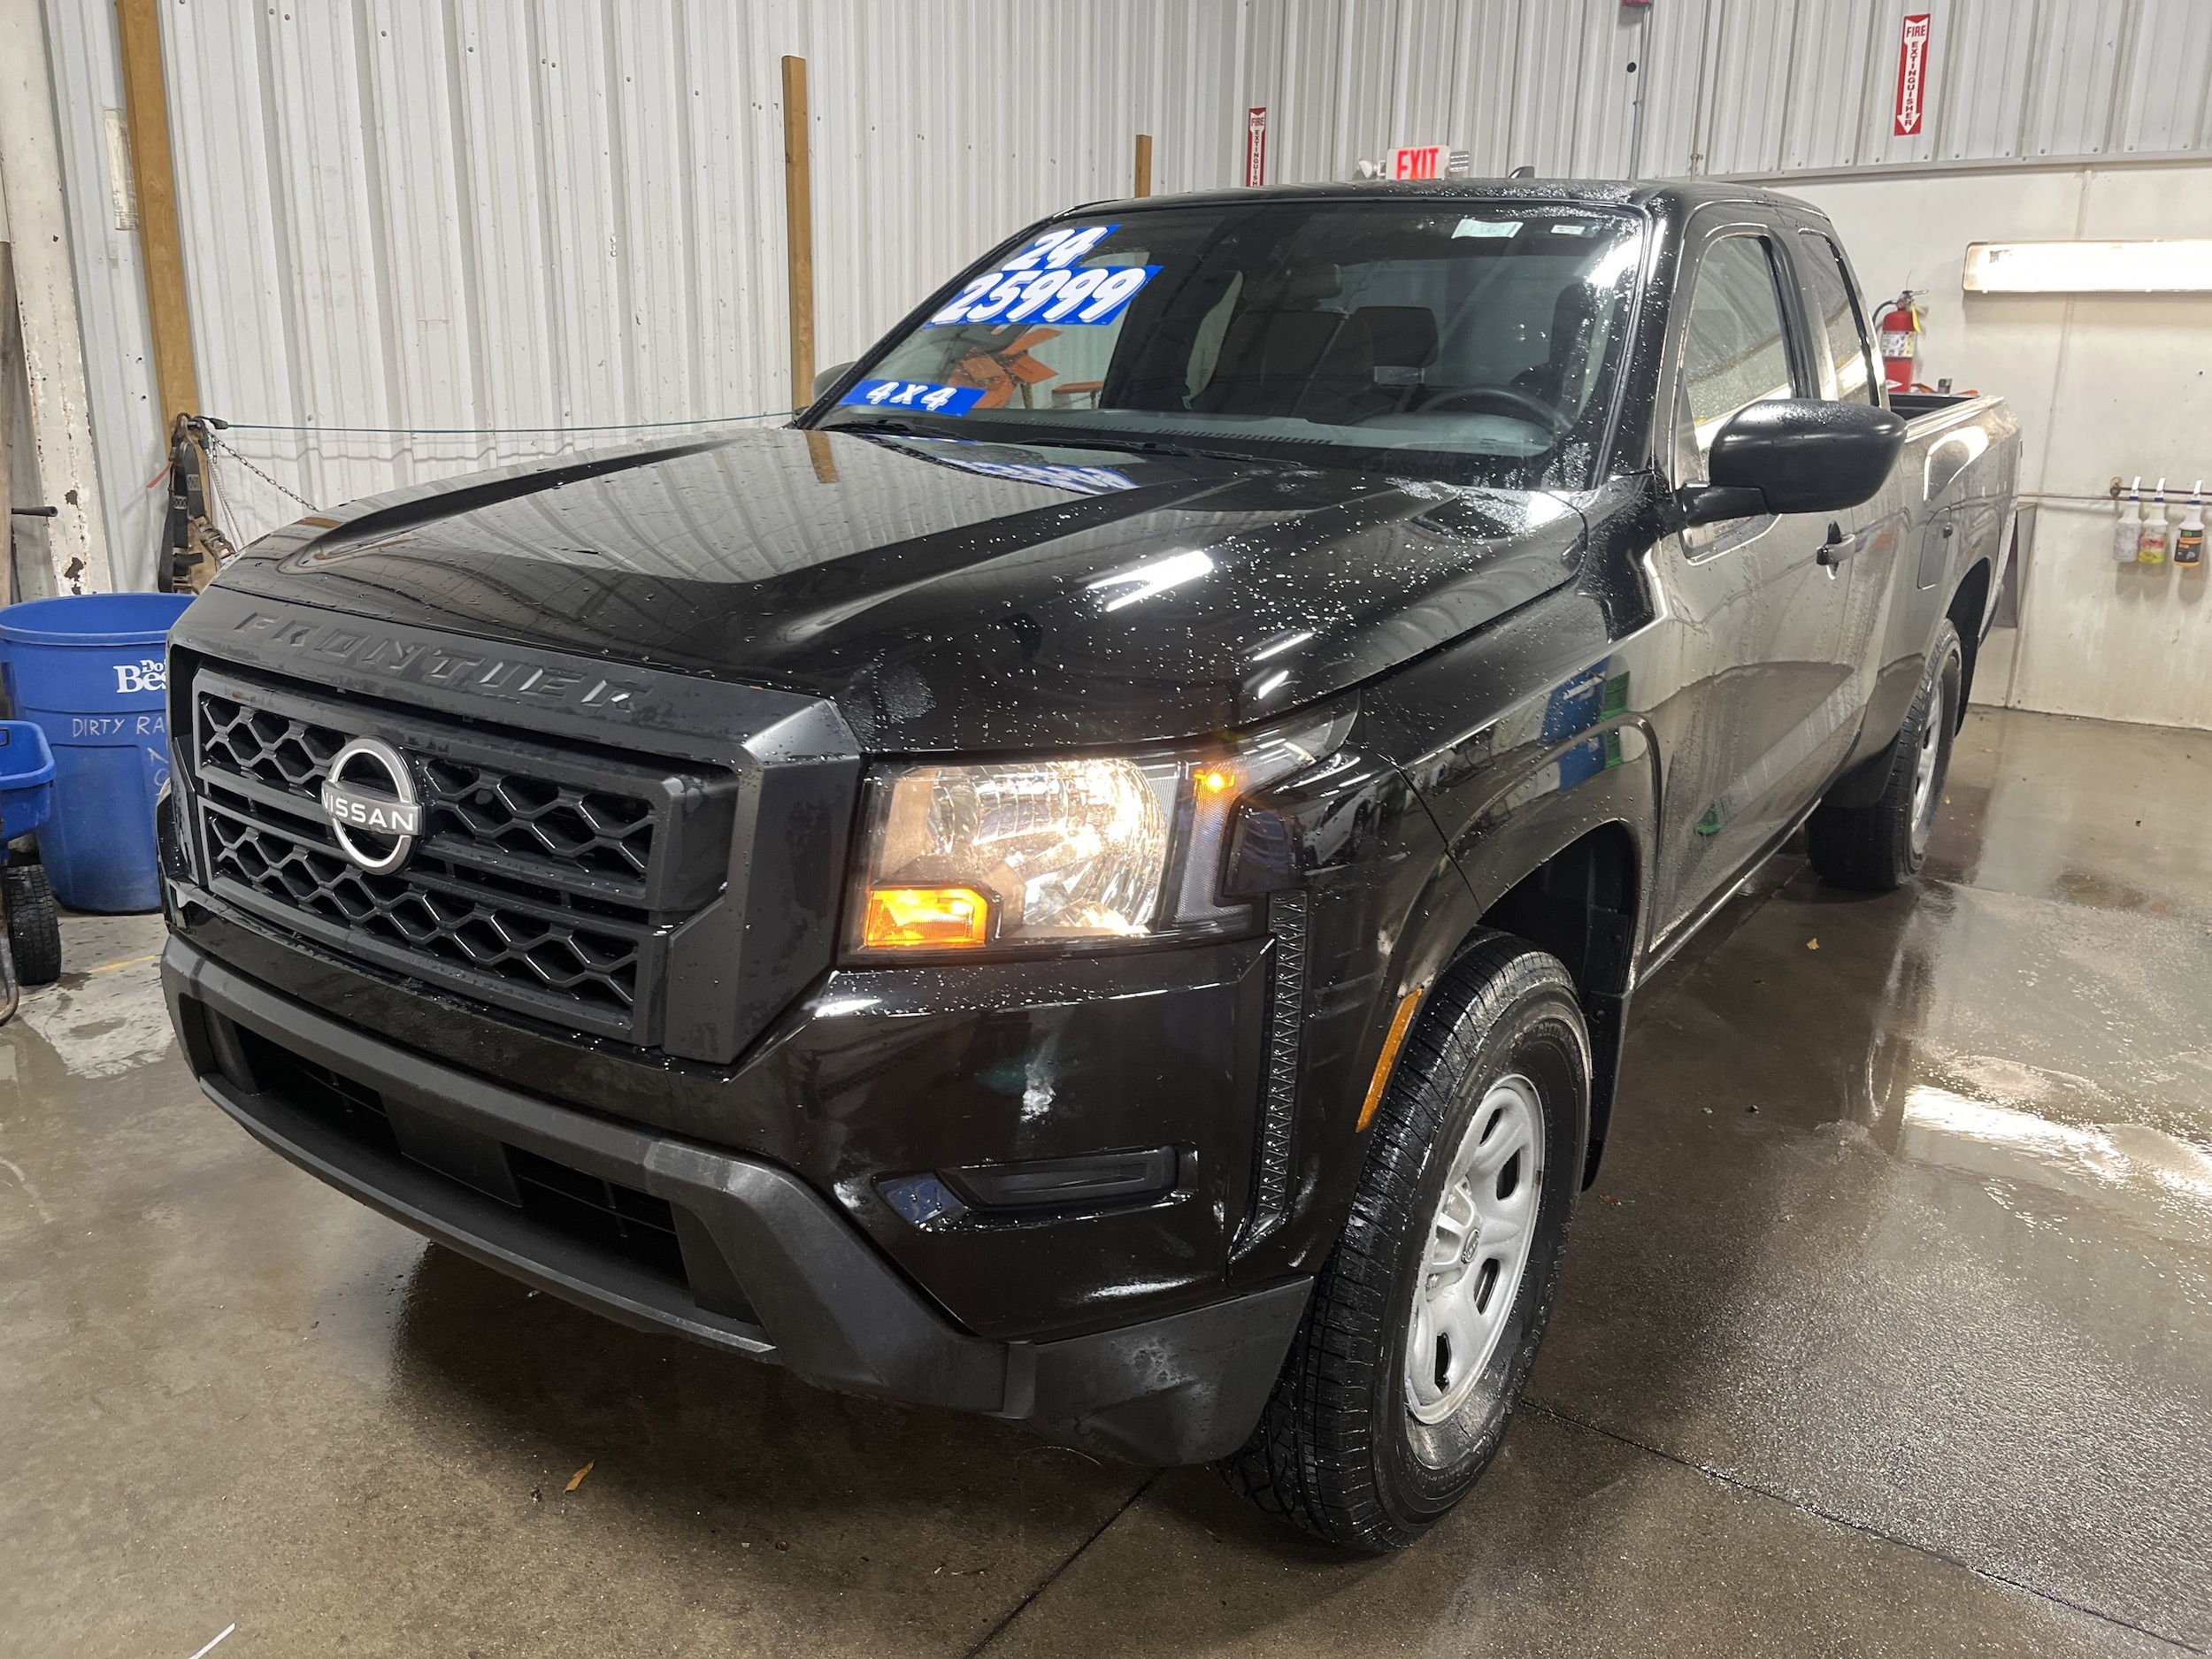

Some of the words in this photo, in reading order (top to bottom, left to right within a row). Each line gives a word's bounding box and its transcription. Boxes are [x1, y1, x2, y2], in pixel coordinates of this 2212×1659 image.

[1906, 25, 1926, 38] FIRE
[1904, 41, 1918, 127] EXTINGUISHER
[1250, 117, 1264, 127] FIRE
[1396, 147, 1440, 180] EXIT
[1002, 227, 1109, 271] 24
[931, 267, 1148, 324] 25999
[234, 611, 655, 713] FRONTIER
[72, 718, 126, 738] DIRTY
[321, 787, 414, 831] NISSAN
